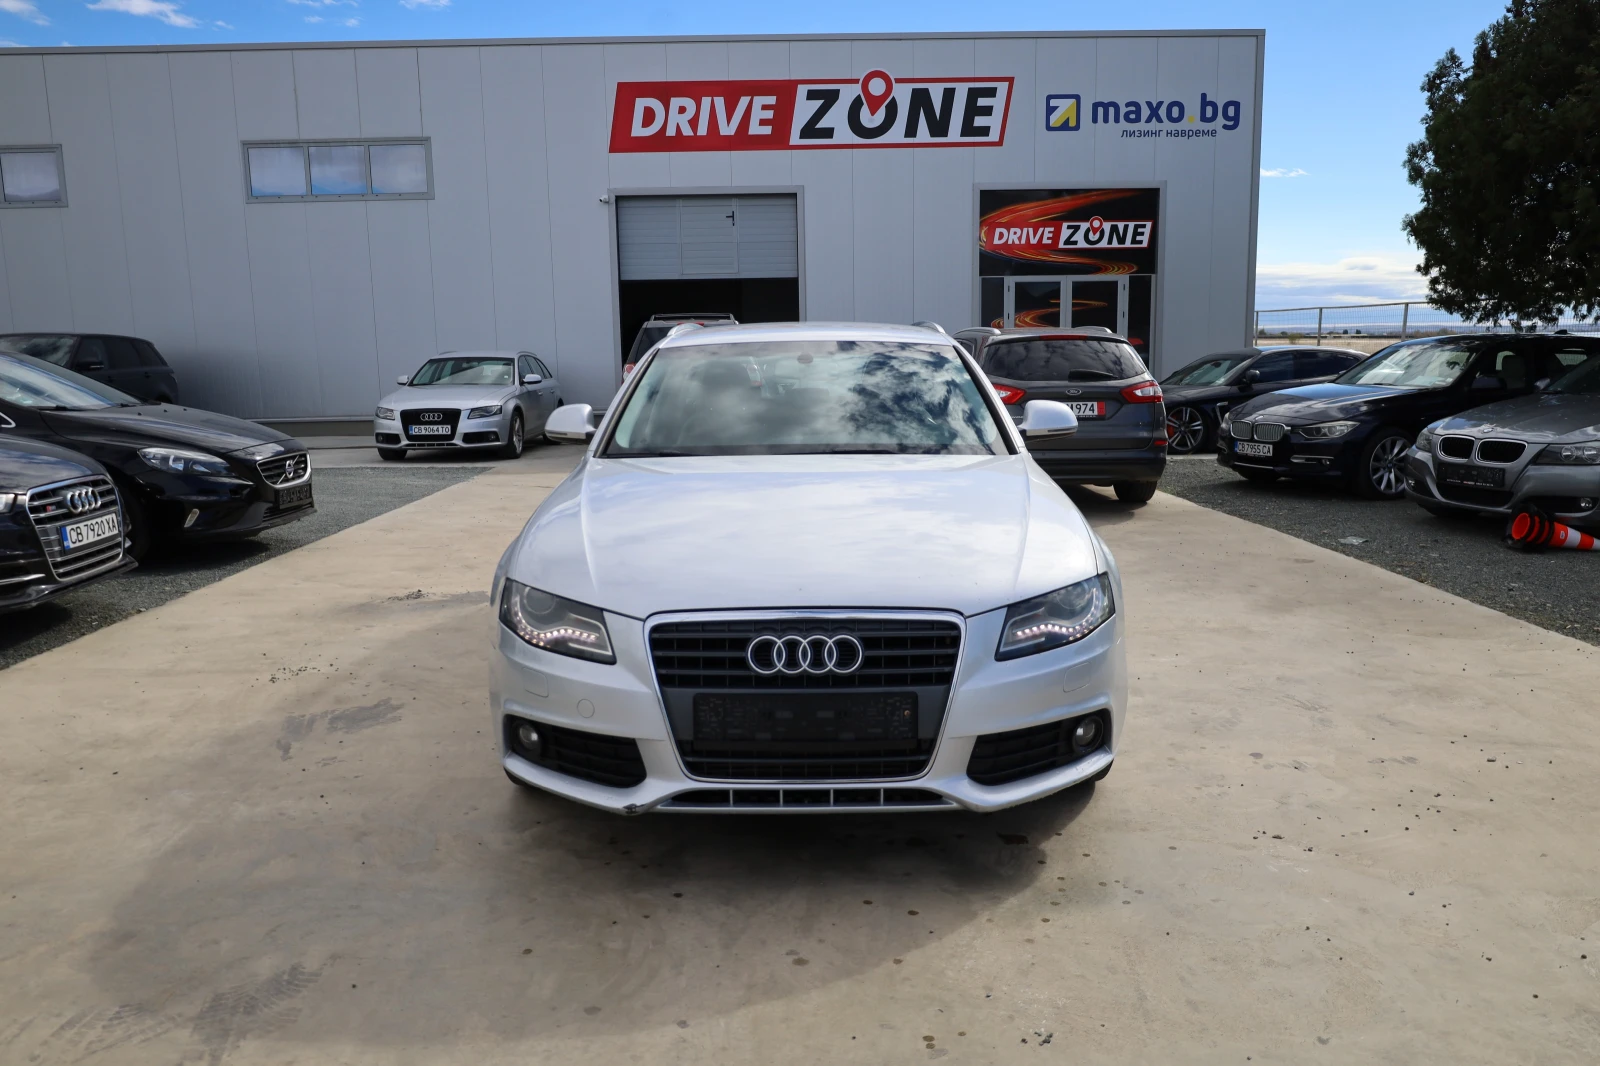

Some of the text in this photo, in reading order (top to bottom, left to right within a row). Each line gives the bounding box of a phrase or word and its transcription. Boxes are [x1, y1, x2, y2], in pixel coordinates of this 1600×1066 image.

[630, 87, 998, 139] DRIVE ZONE
[1091, 92, 1241, 130] maxo.bg
[1120, 128, 1217, 140] лизинг навреме
[993, 223, 1147, 246] DRIVE ZONE
[413, 426, 423, 434] CB
[423, 426, 440, 434] 9064
[69, 516, 117, 544] CB 7920 XA
